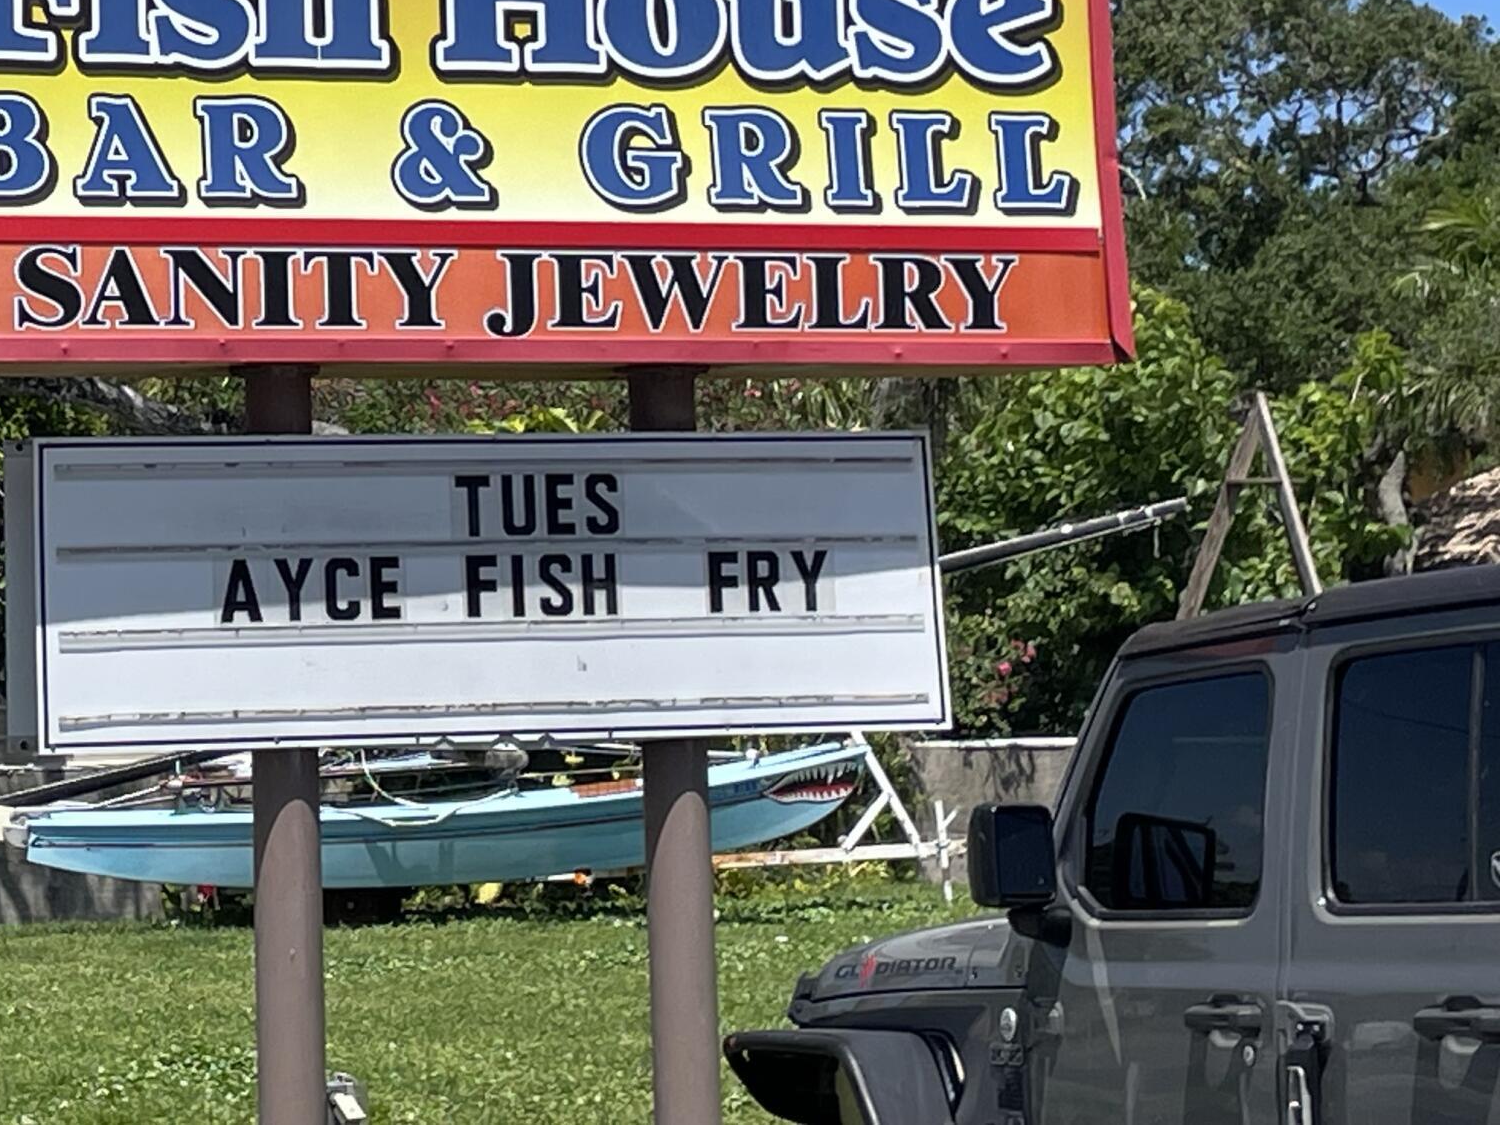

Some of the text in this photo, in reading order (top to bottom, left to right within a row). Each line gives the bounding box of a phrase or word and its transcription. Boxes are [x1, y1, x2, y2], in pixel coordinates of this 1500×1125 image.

[391, 99, 498, 213] &
[578, 103, 1080, 216] GRILL
[13, 245, 1019, 340] SANITY JEWELRY
[454, 473, 621, 538] TUES
[220, 549, 829, 623] AYCE FISH FRY
